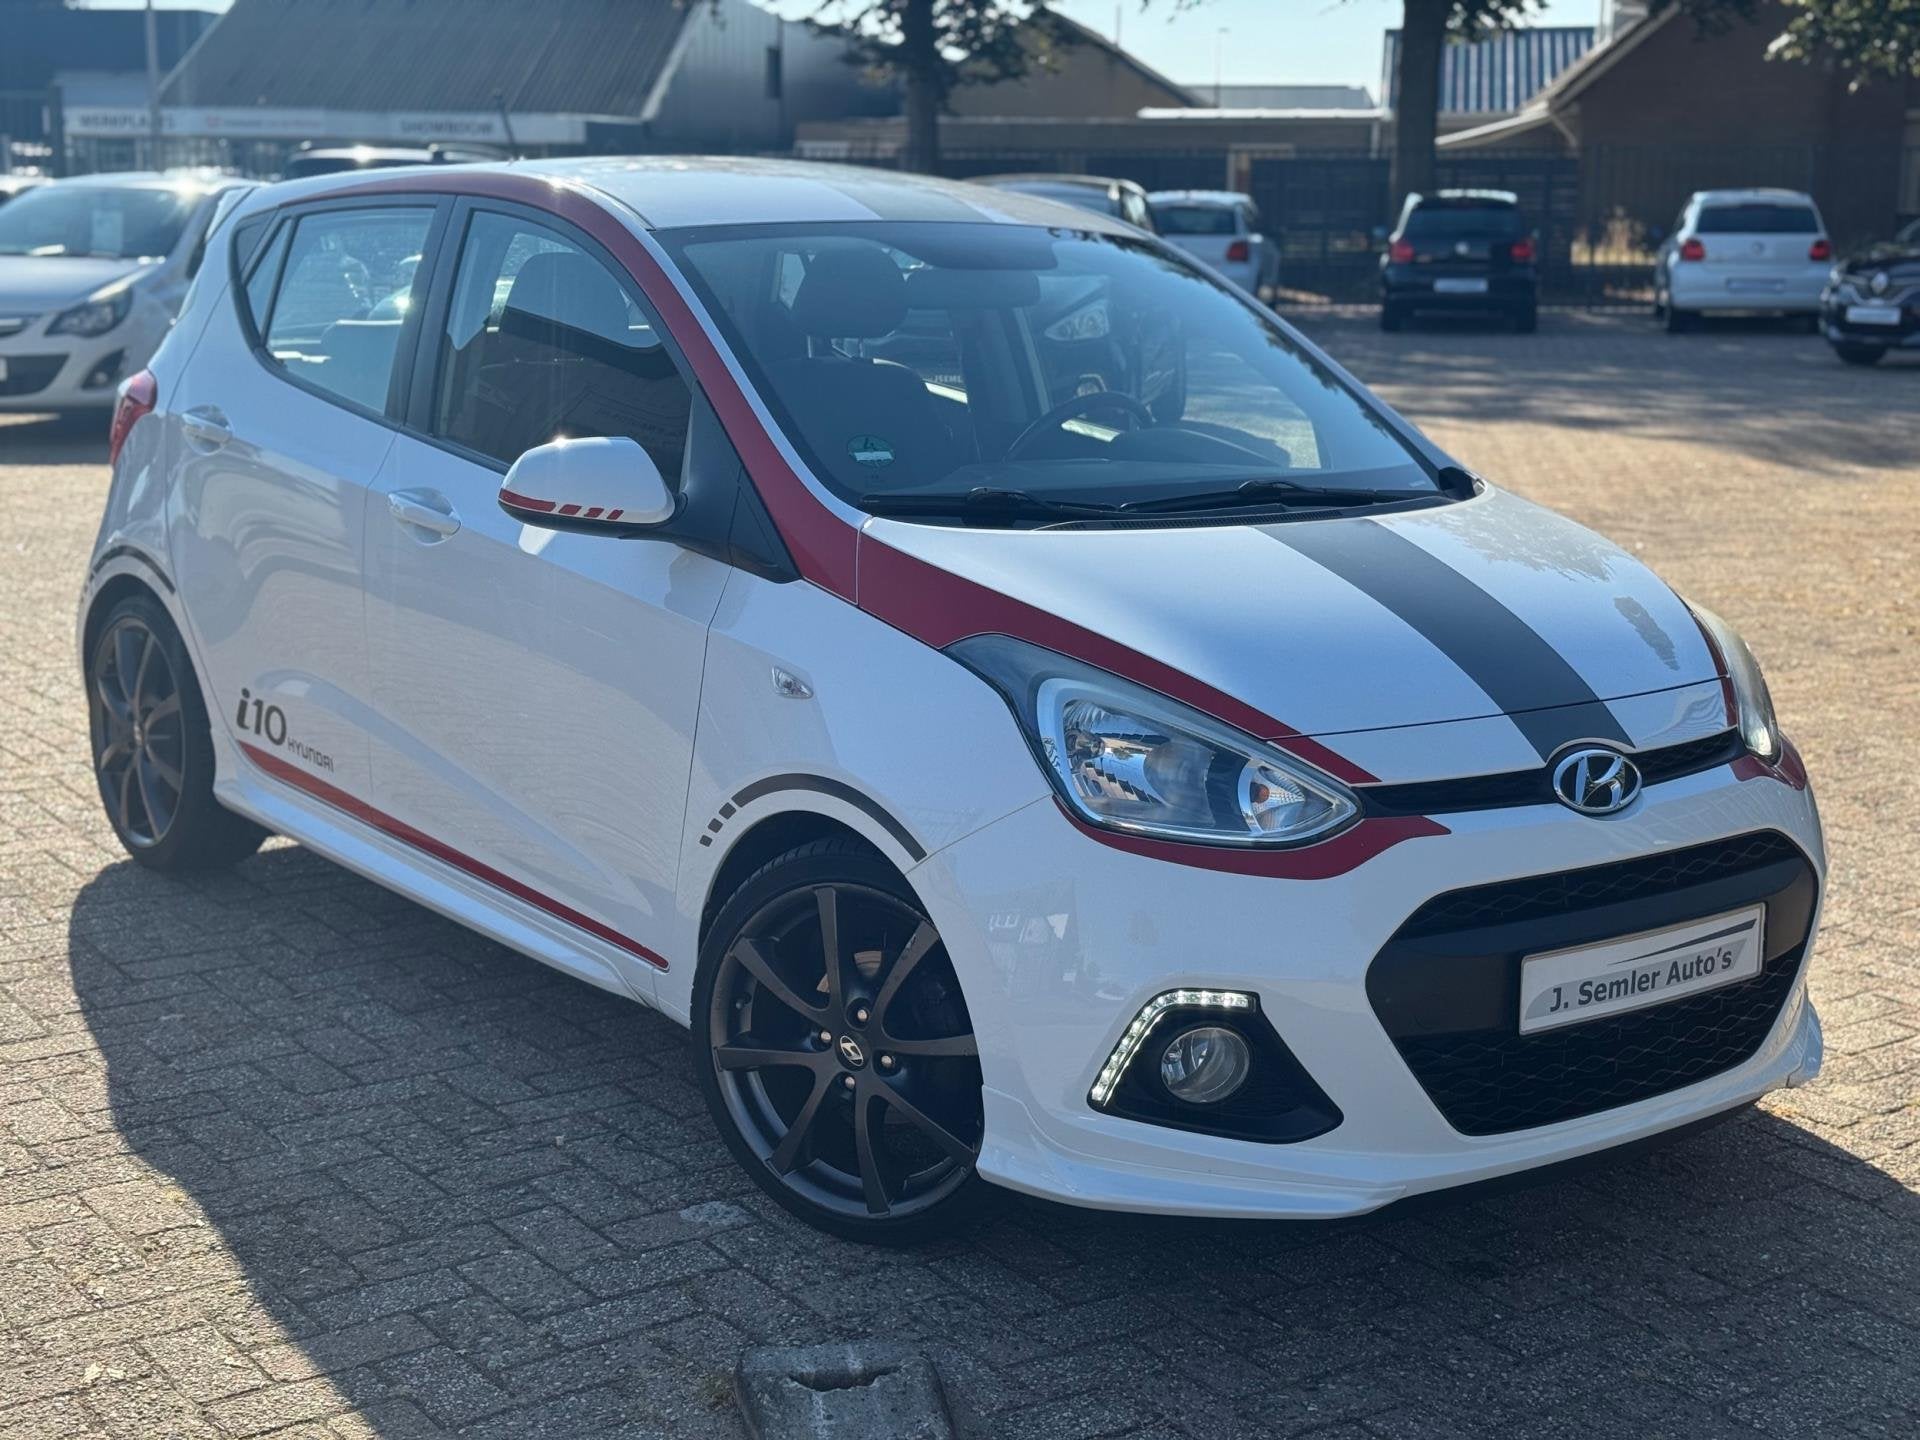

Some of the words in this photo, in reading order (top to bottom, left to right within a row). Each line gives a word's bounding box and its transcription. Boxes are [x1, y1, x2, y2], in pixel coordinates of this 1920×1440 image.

[236, 687, 287, 746] i10
[287, 737, 334, 773] HYUNDAI
[1550, 987, 1569, 1012] J.
[1578, 970, 1661, 1006] Semler
[1665, 946, 1733, 986] Auto's
